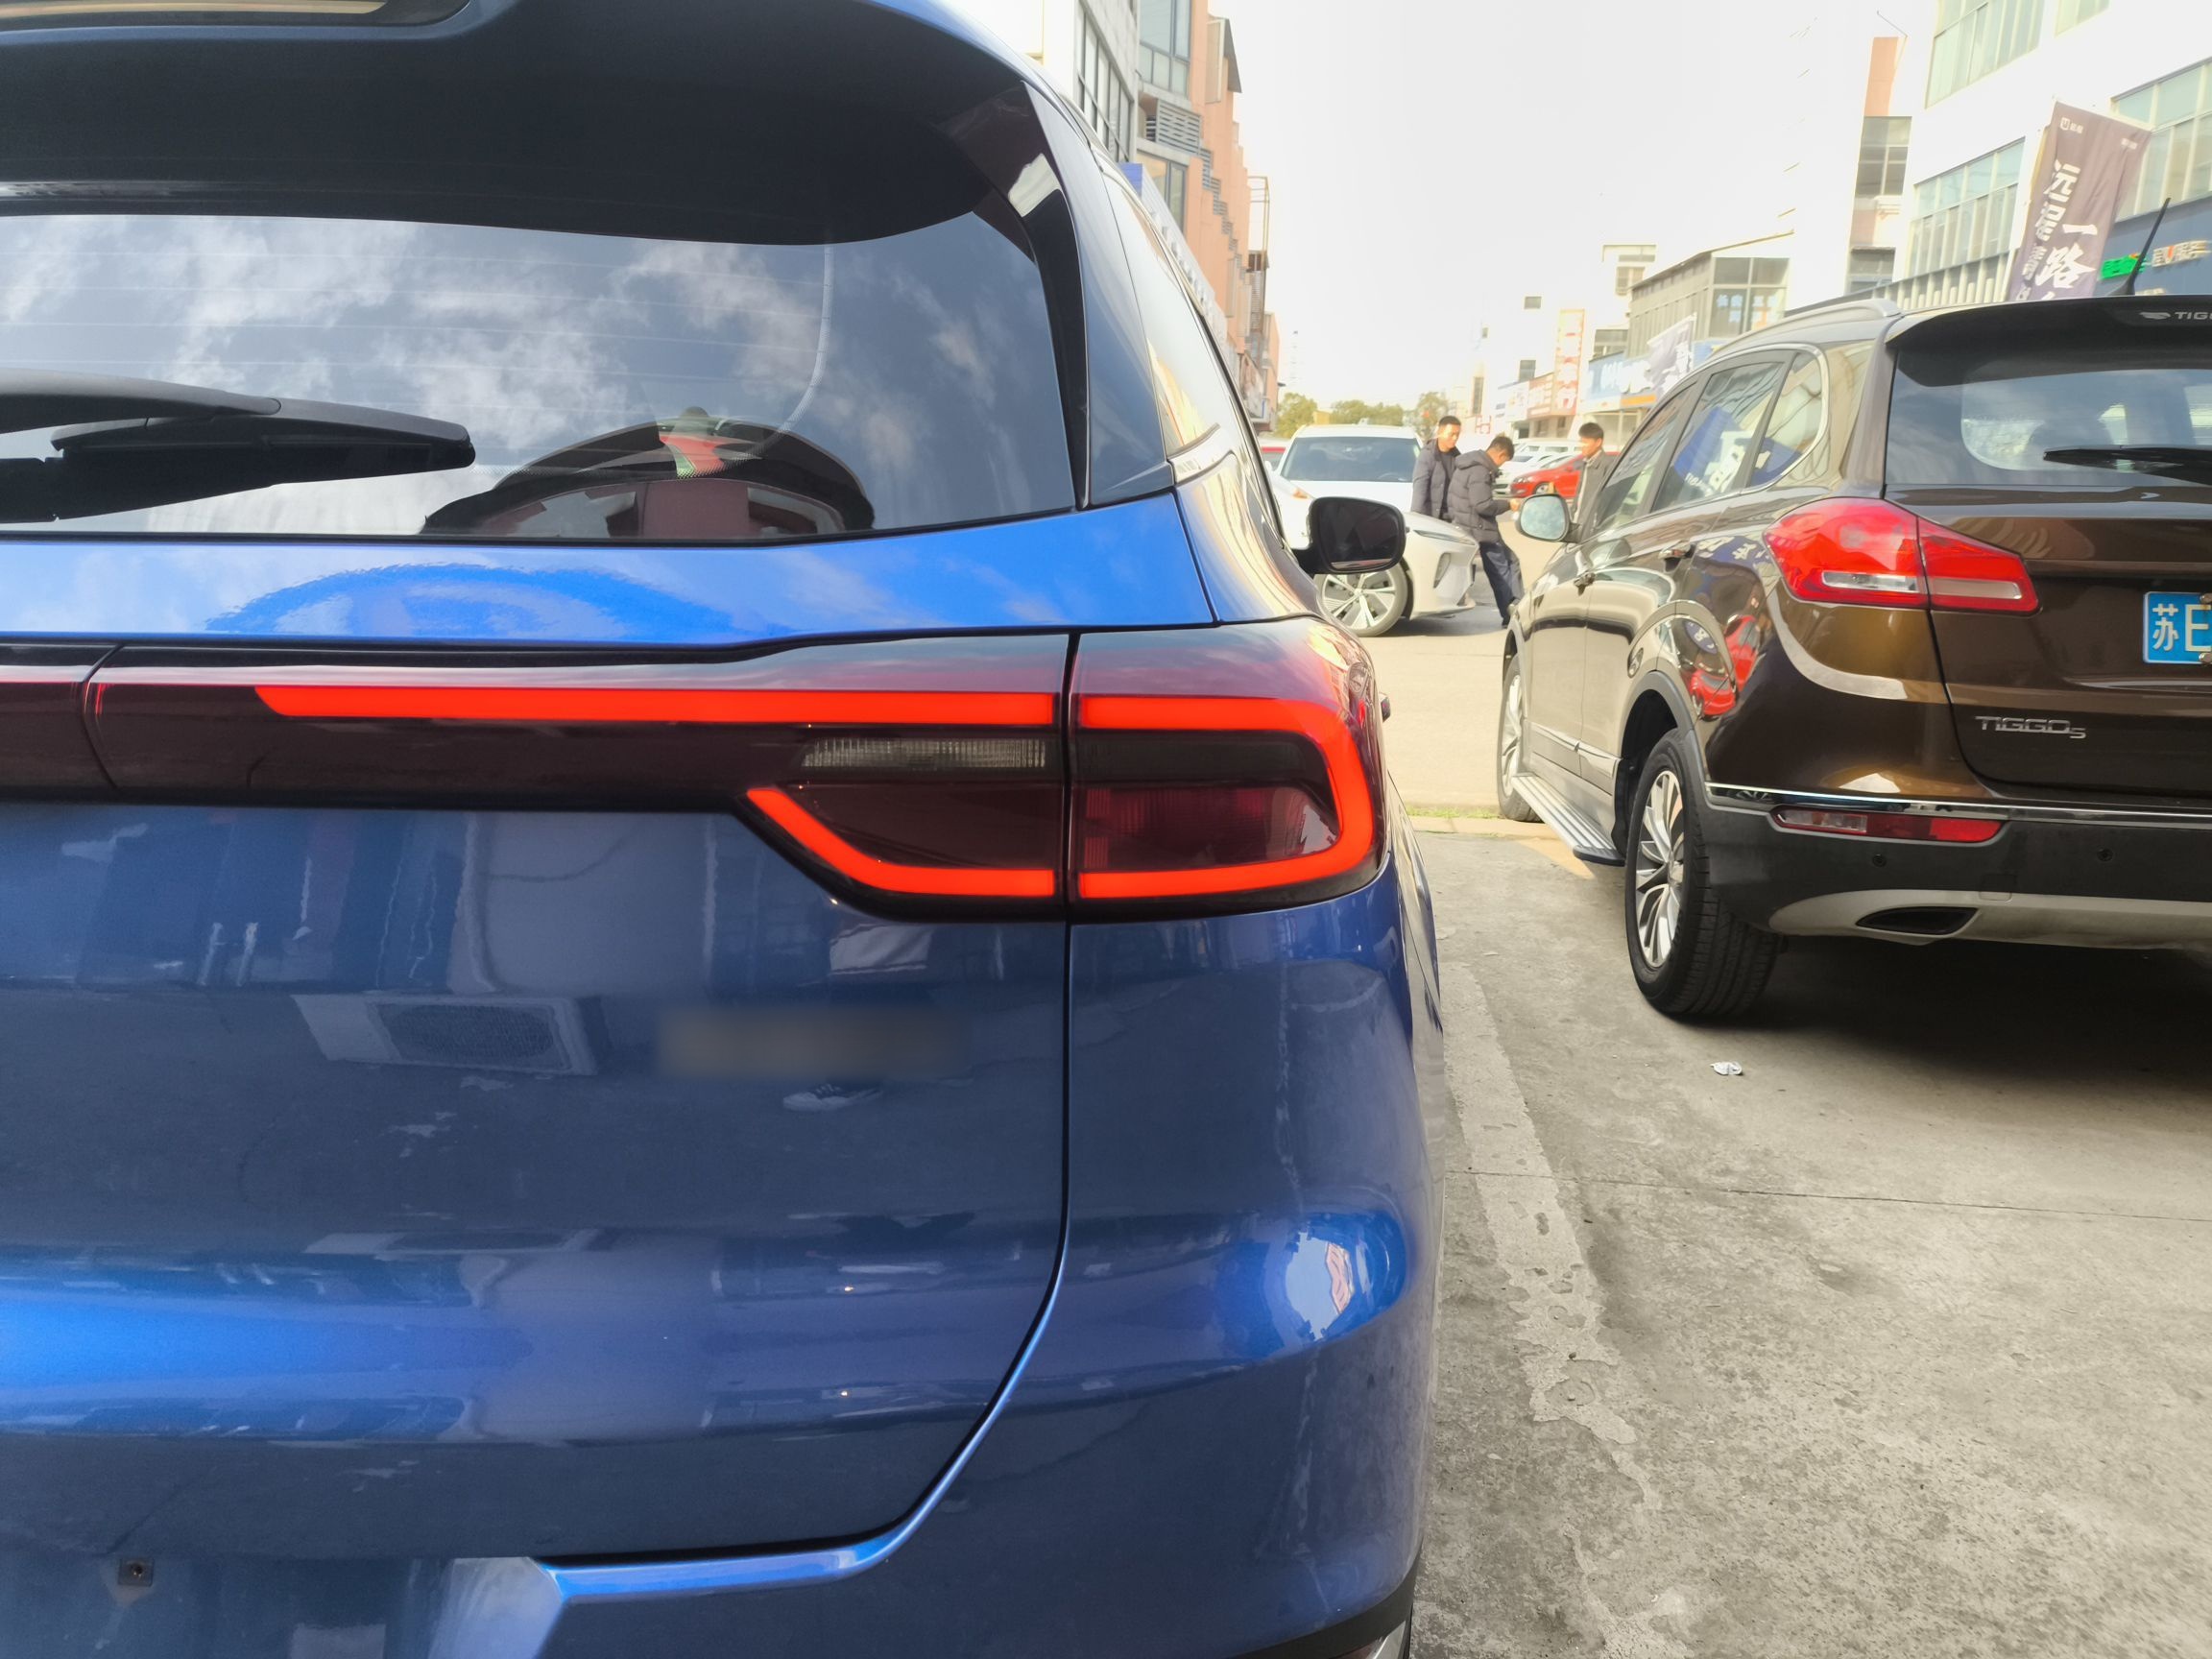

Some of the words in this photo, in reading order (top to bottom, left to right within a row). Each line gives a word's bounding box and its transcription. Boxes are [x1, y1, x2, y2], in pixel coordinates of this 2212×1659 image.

[2035, 224, 2097, 299] 一路
[2174, 311, 2212, 320] TIG
[2152, 603, 2212, 652] 苏E
